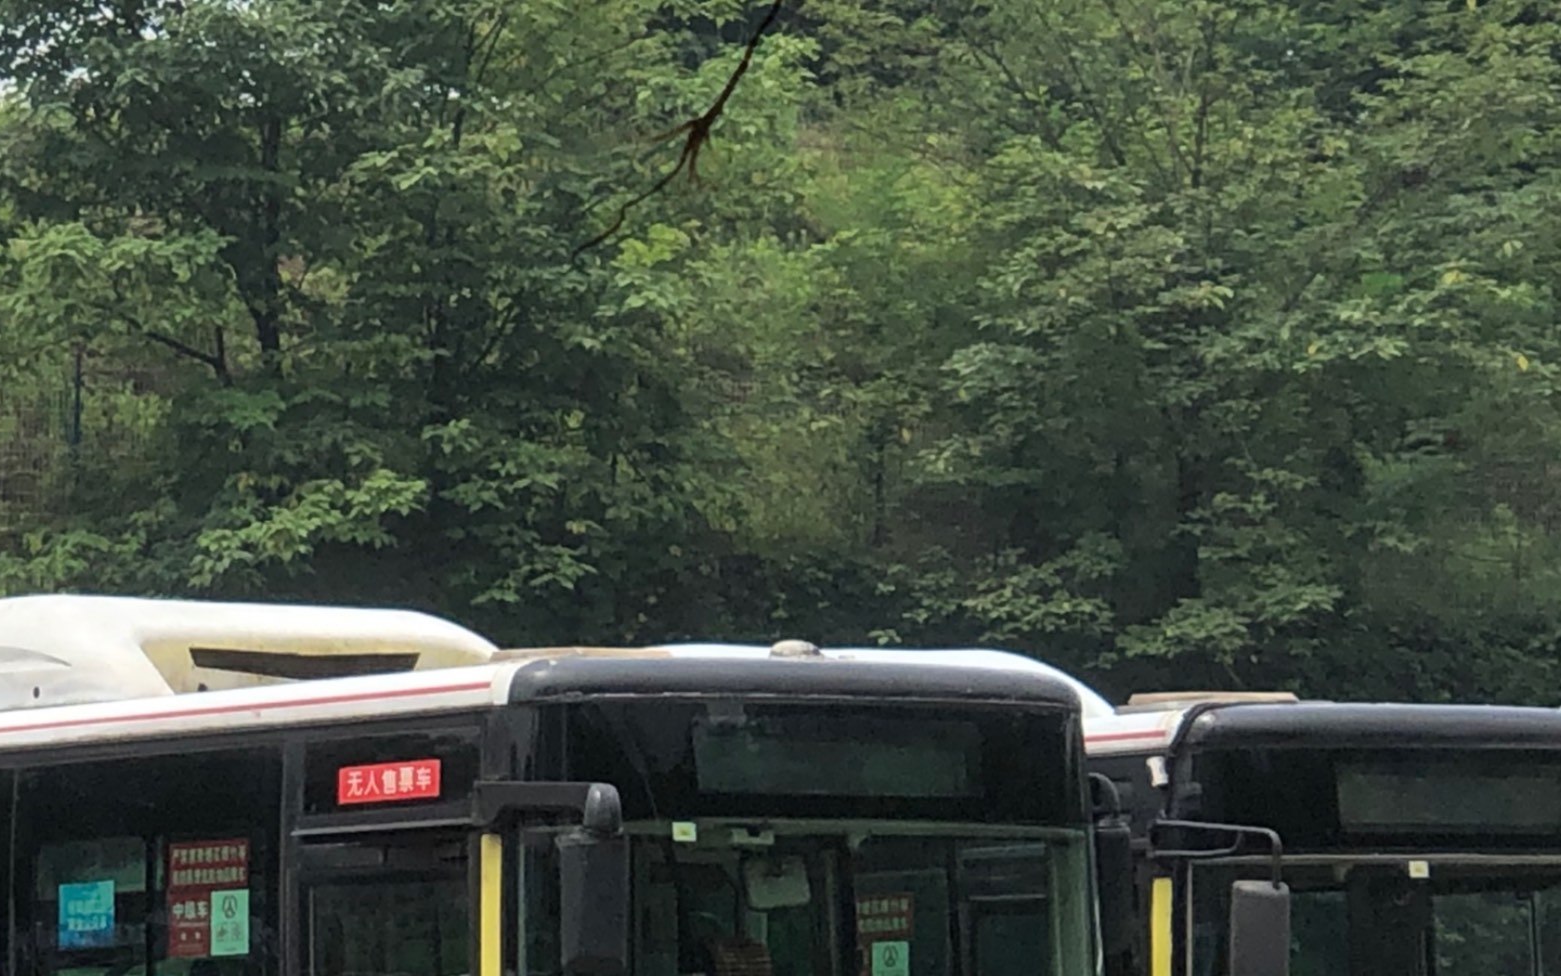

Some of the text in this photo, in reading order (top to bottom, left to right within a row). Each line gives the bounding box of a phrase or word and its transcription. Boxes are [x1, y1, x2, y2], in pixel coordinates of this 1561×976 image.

[347, 766, 432, 797] 无人售票车
